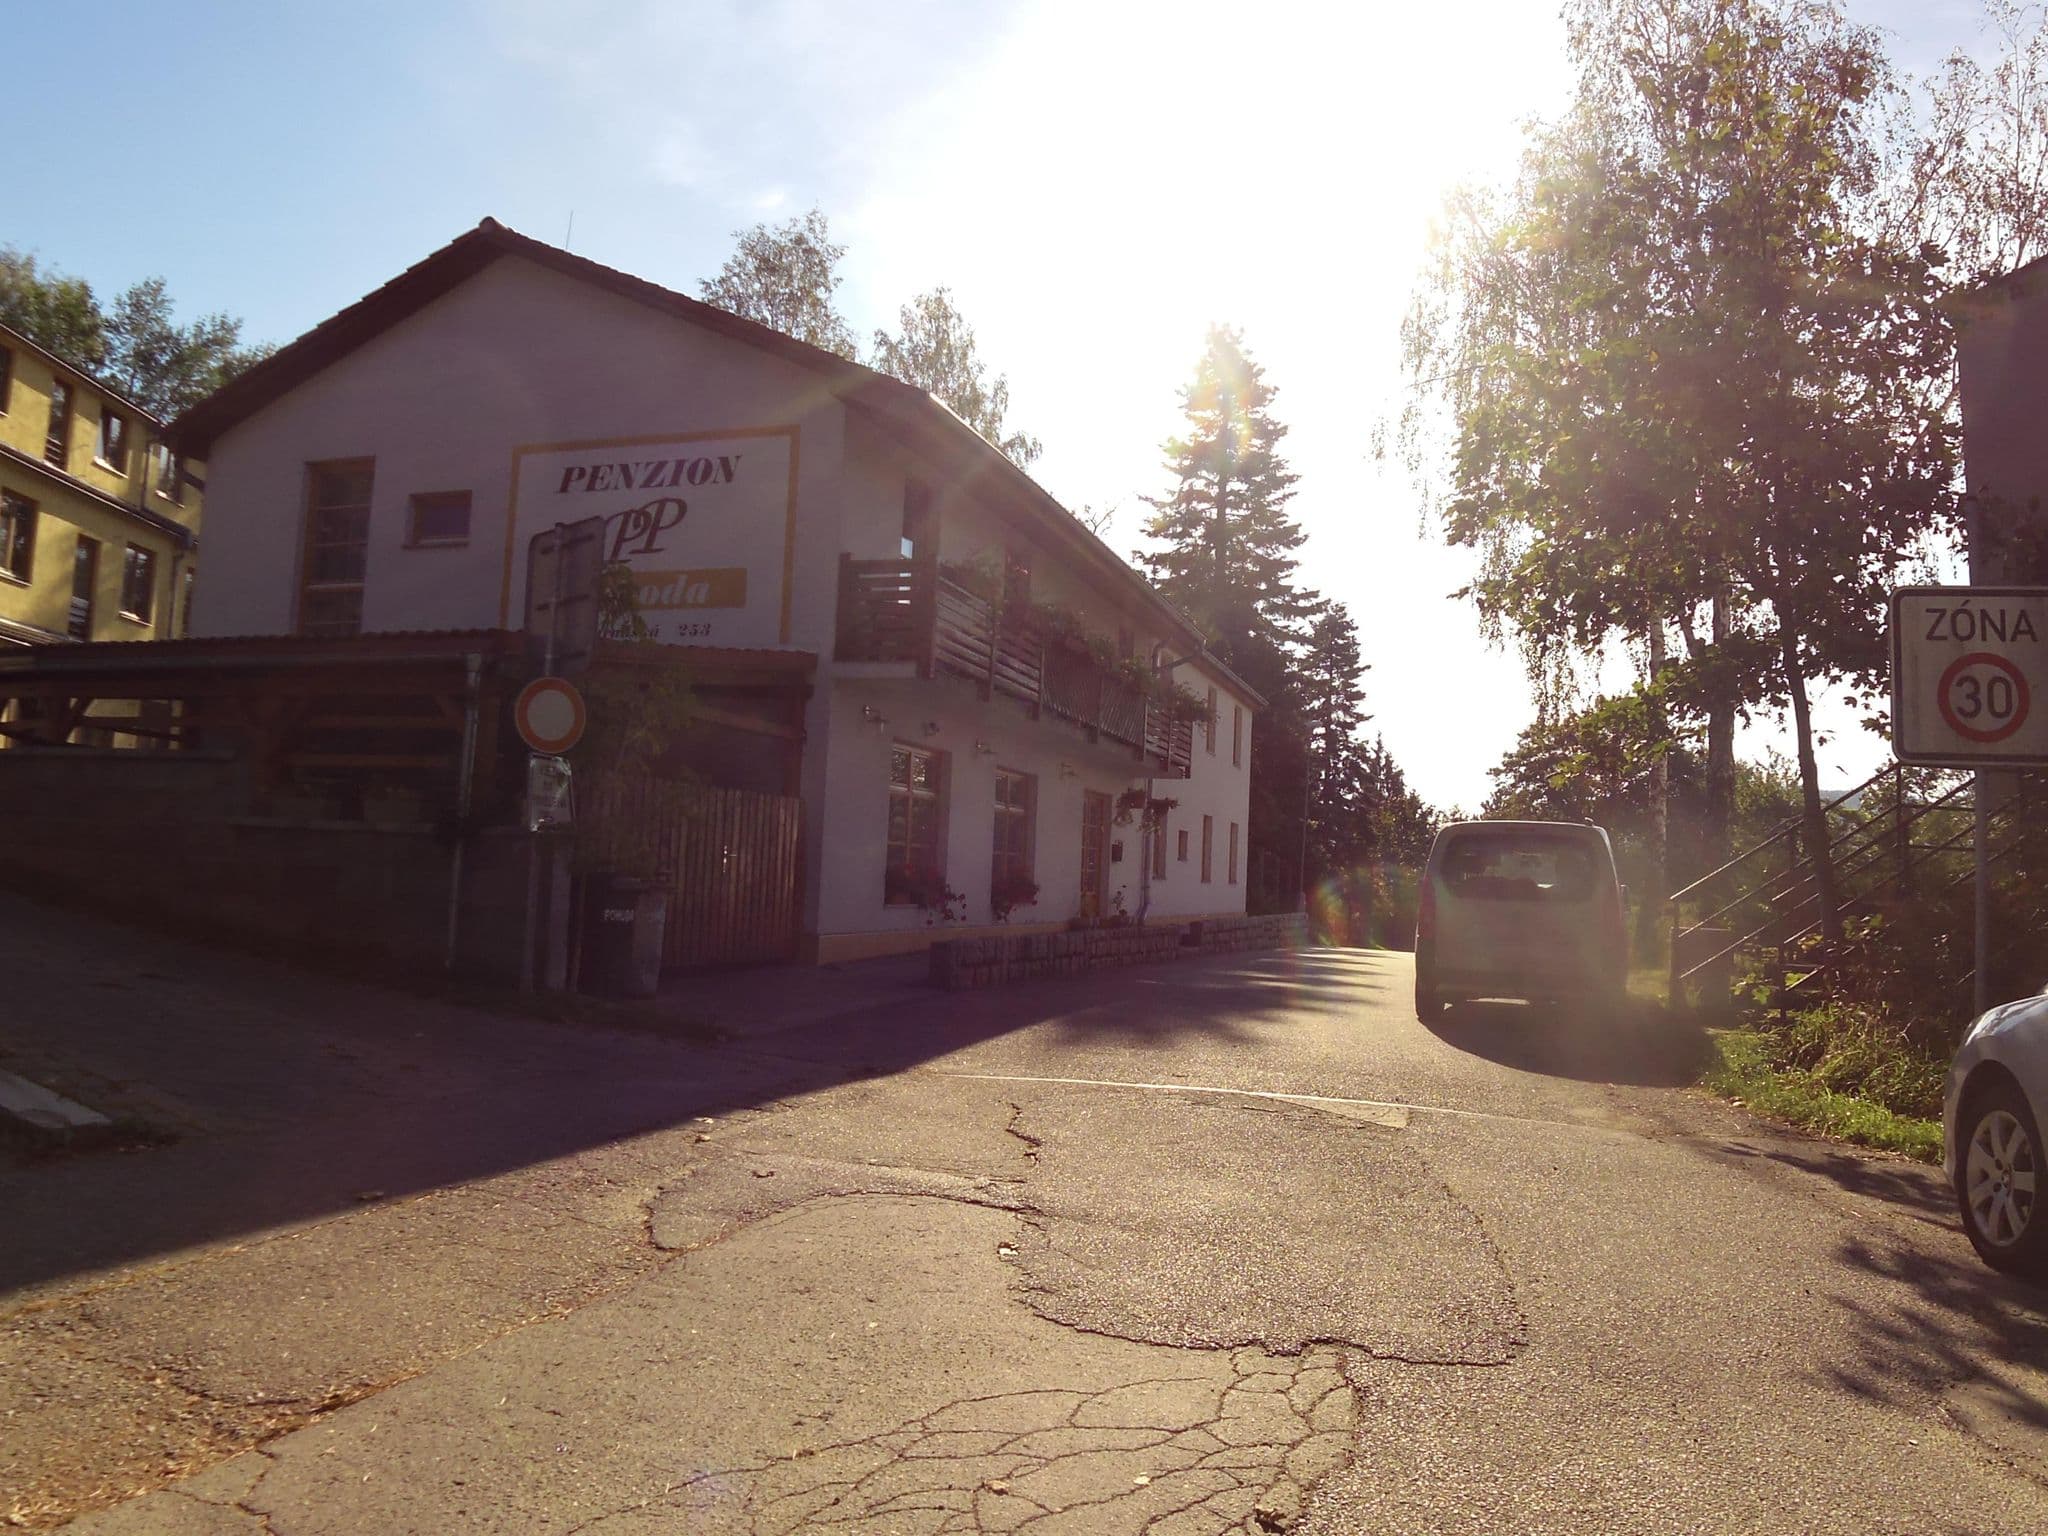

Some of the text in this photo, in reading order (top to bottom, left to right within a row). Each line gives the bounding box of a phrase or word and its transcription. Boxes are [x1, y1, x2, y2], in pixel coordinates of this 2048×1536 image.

[556, 455, 743, 493] PENZION
[1925, 599, 2038, 643] ZÓNA
[1955, 676, 2014, 719] 30
